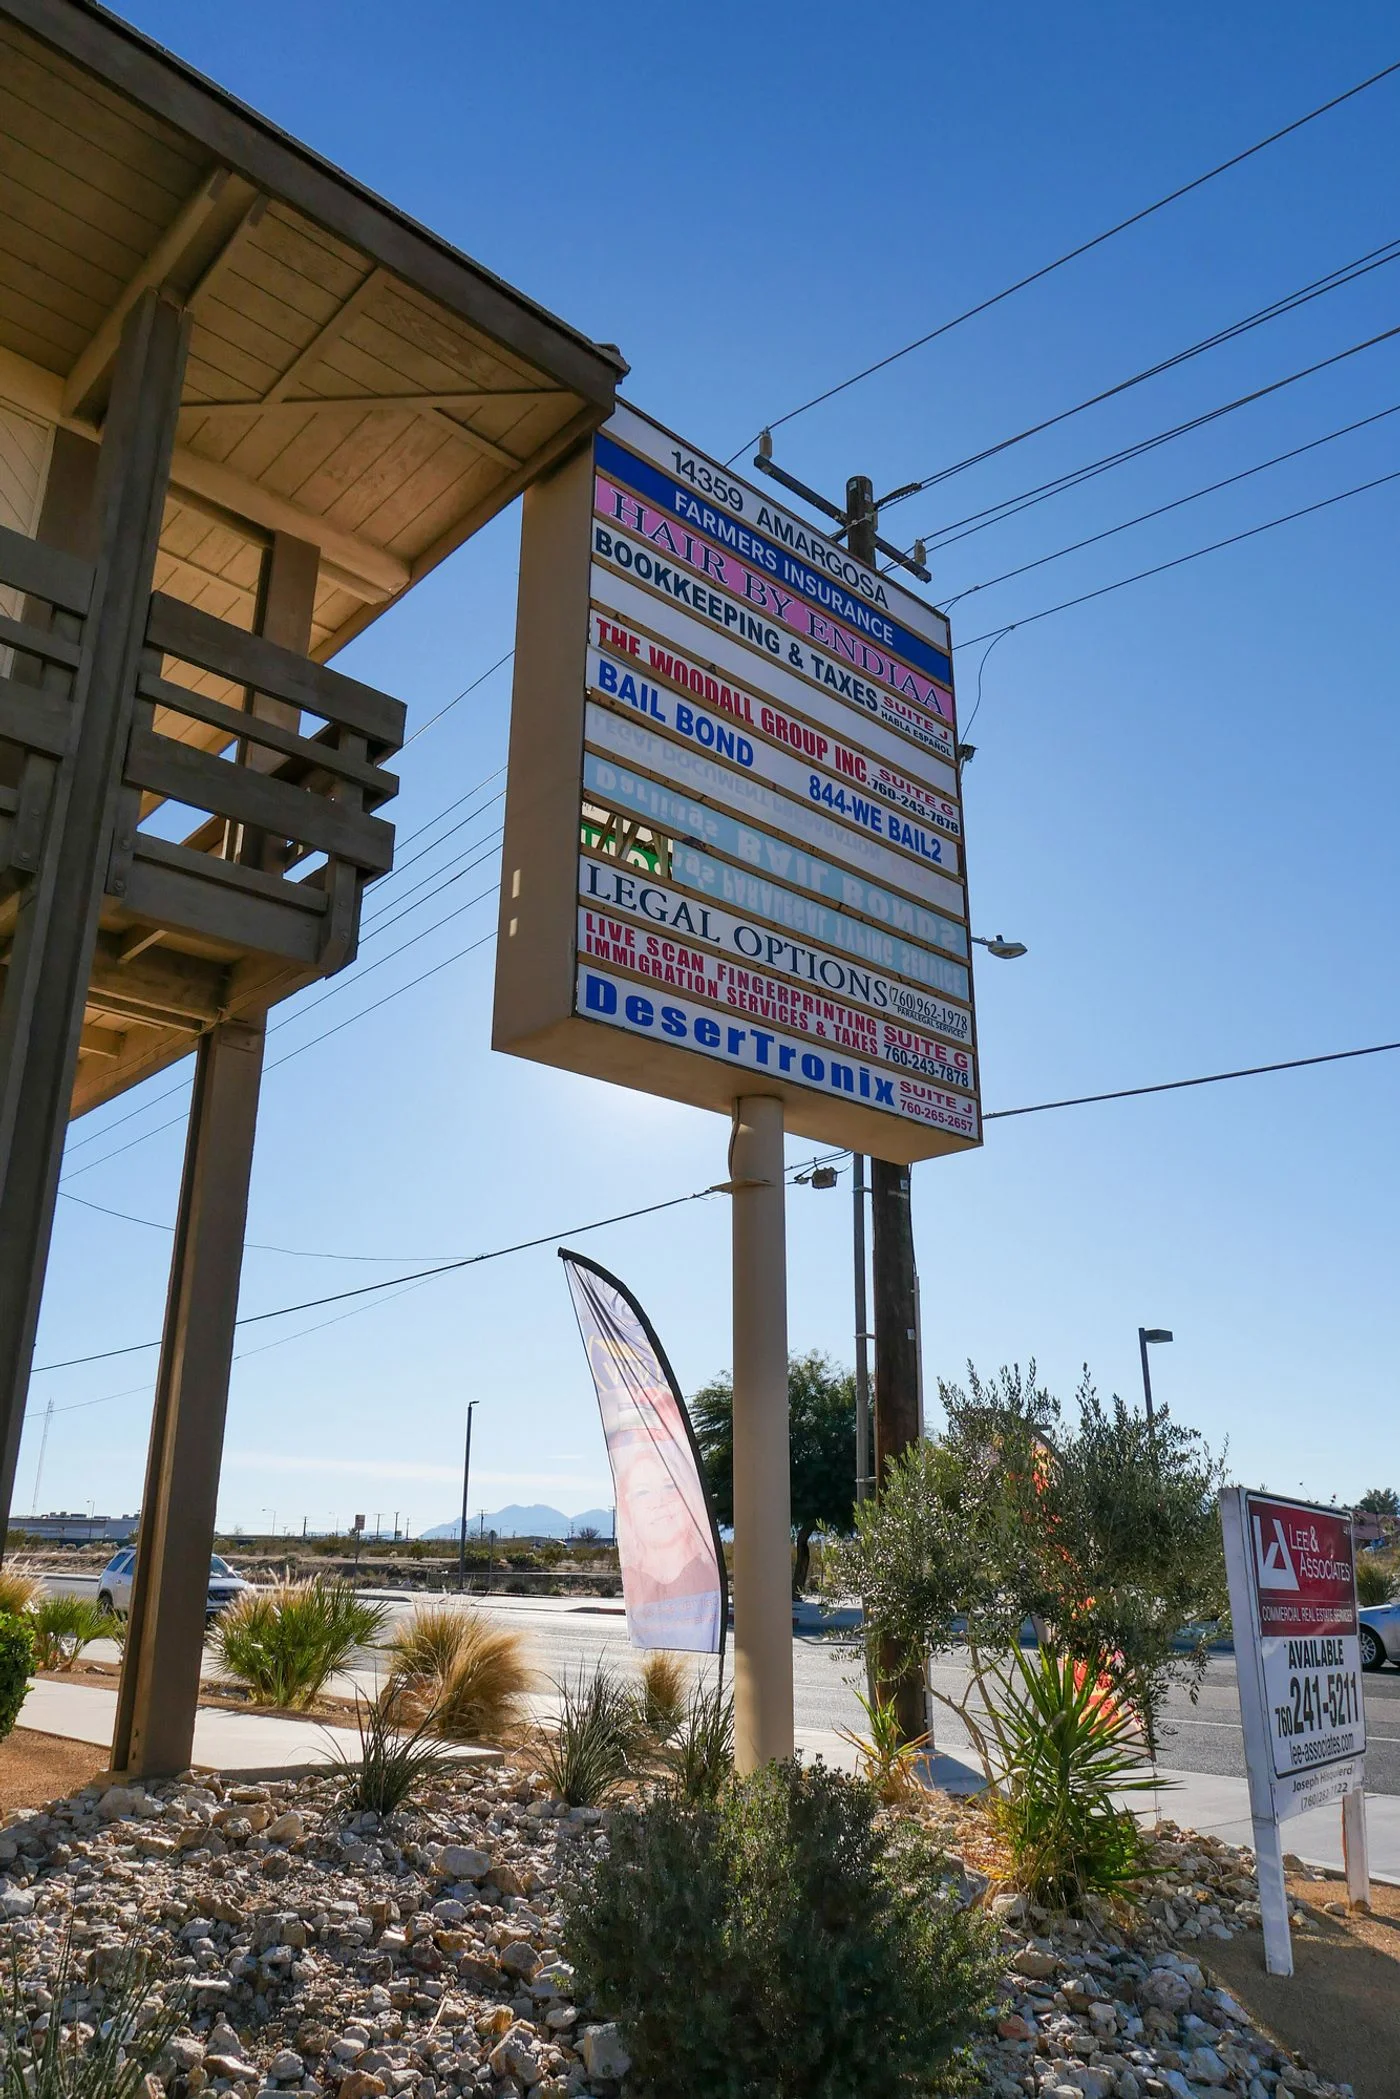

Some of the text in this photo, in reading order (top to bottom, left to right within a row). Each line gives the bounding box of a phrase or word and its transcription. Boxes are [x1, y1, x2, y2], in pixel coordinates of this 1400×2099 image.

[672, 451, 889, 609] 14359 AMARGOSA
[675, 491, 894, 646] FARMERS INSURANCE
[595, 527, 878, 712] BOOKKEEPING & TAXES
[610, 488, 945, 716] HAIR BY ENDIAA
[596, 617, 870, 785] THE WOODALL GROUP INC.
[883, 696, 948, 741] SUITE J
[881, 710, 952, 757] HABLA ESPAÑOL
[598, 658, 942, 863] BAIL BOND 844-WE BAIL2
[870, 778, 959, 834] 760-243-7878
[879, 768, 954, 817] SUITE G
[586, 863, 888, 1007] LEGAL OPTIONS
[586, 912, 877, 1037] LIVE SCAN FINGERPRINTING
[586, 934, 878, 1055] IMMIGRATION SERVICES & TAXES
[586, 974, 895, 1106] DeserTronix
[884, 1025, 968, 1069] SUITE G
[896, 1006, 966, 1039] PARALEGAL SERVICES
[884, 1044, 969, 1088] 760-243-7878
[900, 1080, 972, 1114] SUITE J
[900, 1099, 973, 1133] 760-265-2657
[1310, 1525, 1320, 1552] &
[1262, 1606, 1301, 1621] COMMERCIAL
[1301, 1607, 1315, 1621] REAL
[1289, 1639, 1344, 1669] AVAILABLE
[1275, 1672, 1359, 1738] 760 241-5211
[1289, 1732, 1354, 1766] lee-associates.com
[1292, 1773, 1320, 1792] Joseph
